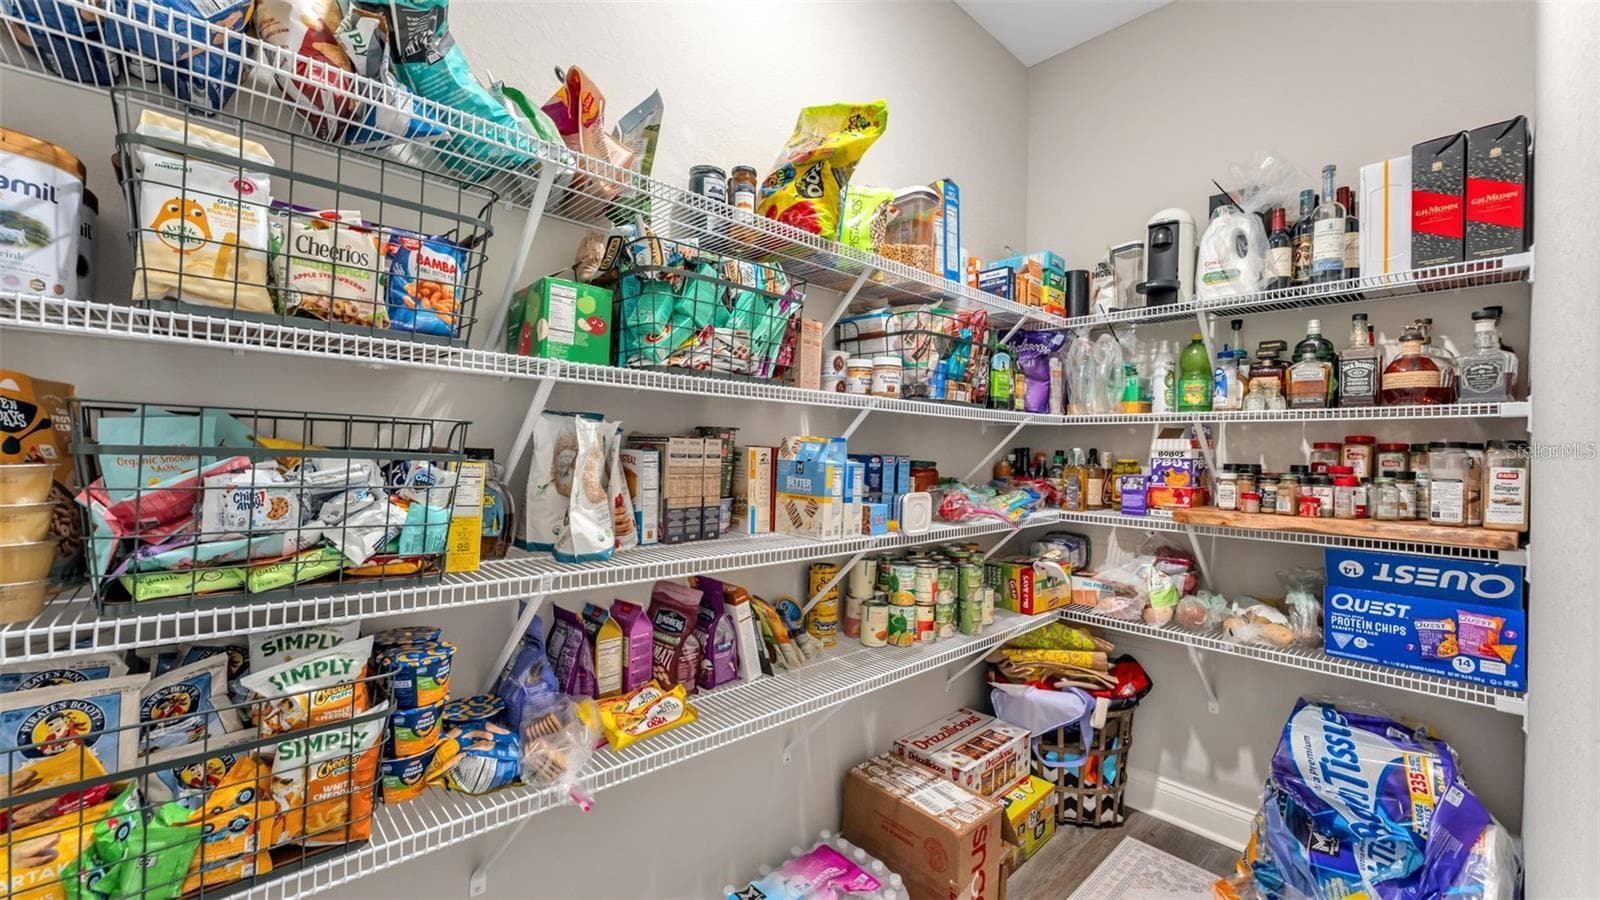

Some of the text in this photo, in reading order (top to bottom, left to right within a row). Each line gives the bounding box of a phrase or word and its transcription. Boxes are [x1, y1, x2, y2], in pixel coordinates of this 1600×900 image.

[295, 234, 369, 266] Cheerios
[416, 252, 457, 273] BAMBA
[293, 272, 317, 281] APPLE
[116, 456, 159, 470] Organic
[786, 478, 812, 488] BETTER
[1494, 485, 1521, 493] Ginger
[233, 491, 260, 503] Chips
[1343, 566, 1360, 577] 14
[1372, 563, 1515, 599] QUEST
[1331, 593, 1411, 619] QUEST
[655, 613, 684, 631] LUNDBERG
[1331, 615, 1407, 636] PROTEIN CHIPS
[261, 633, 344, 657] SIMPLY
[1454, 658, 1472, 668] 14
[268, 658, 354, 691] SIMPLY
[22, 700, 104, 733] PIRATE'S BOOTY
[911, 714, 982, 751] Drizzilicious
[278, 731, 369, 761] SIMPLY
[1303, 735, 1318, 776] Premium
[908, 751, 946, 775] Drizzilicious
[1409, 773, 1429, 795] 235
